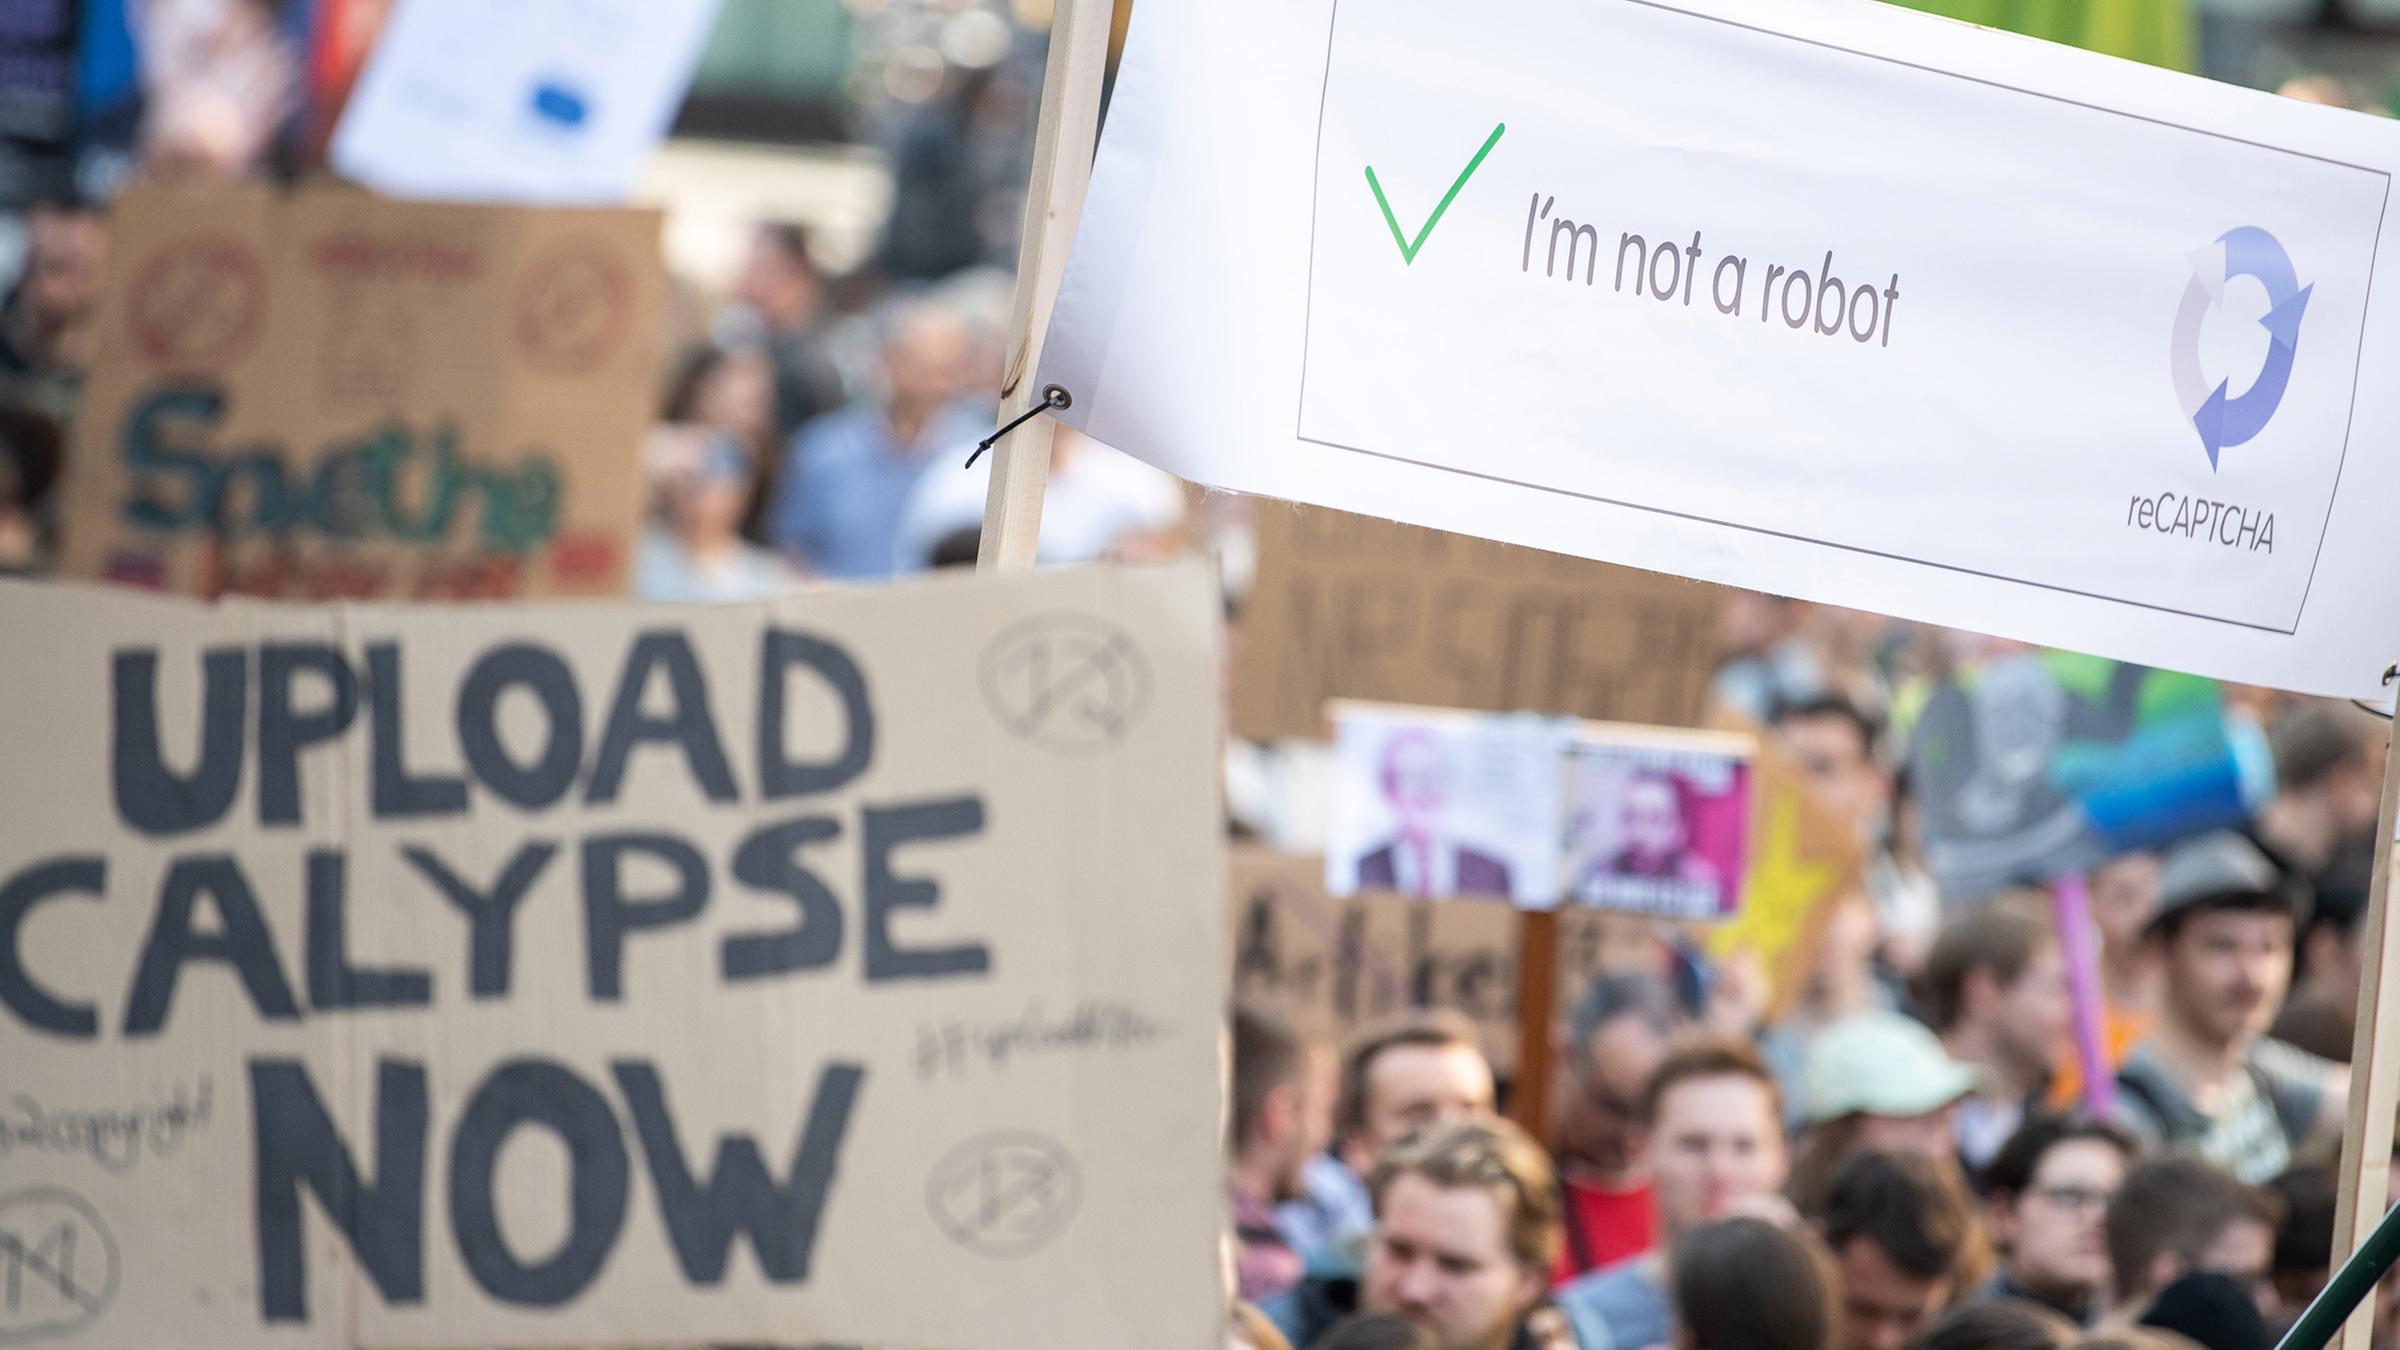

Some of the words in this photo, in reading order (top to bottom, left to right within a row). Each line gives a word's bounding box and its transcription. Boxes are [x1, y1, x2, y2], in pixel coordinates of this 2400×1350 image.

[1522, 192, 1598, 287] I'm
[1614, 230, 1702, 307] not
[1711, 254, 1747, 318] a
[1760, 249, 1900, 349] robot
[2127, 491, 2275, 555] reCAPTCHA
[110, 626, 877, 842] UPLOAD
[0, 794, 993, 1042] CALYPSE
[246, 1054, 867, 1327] NOW
